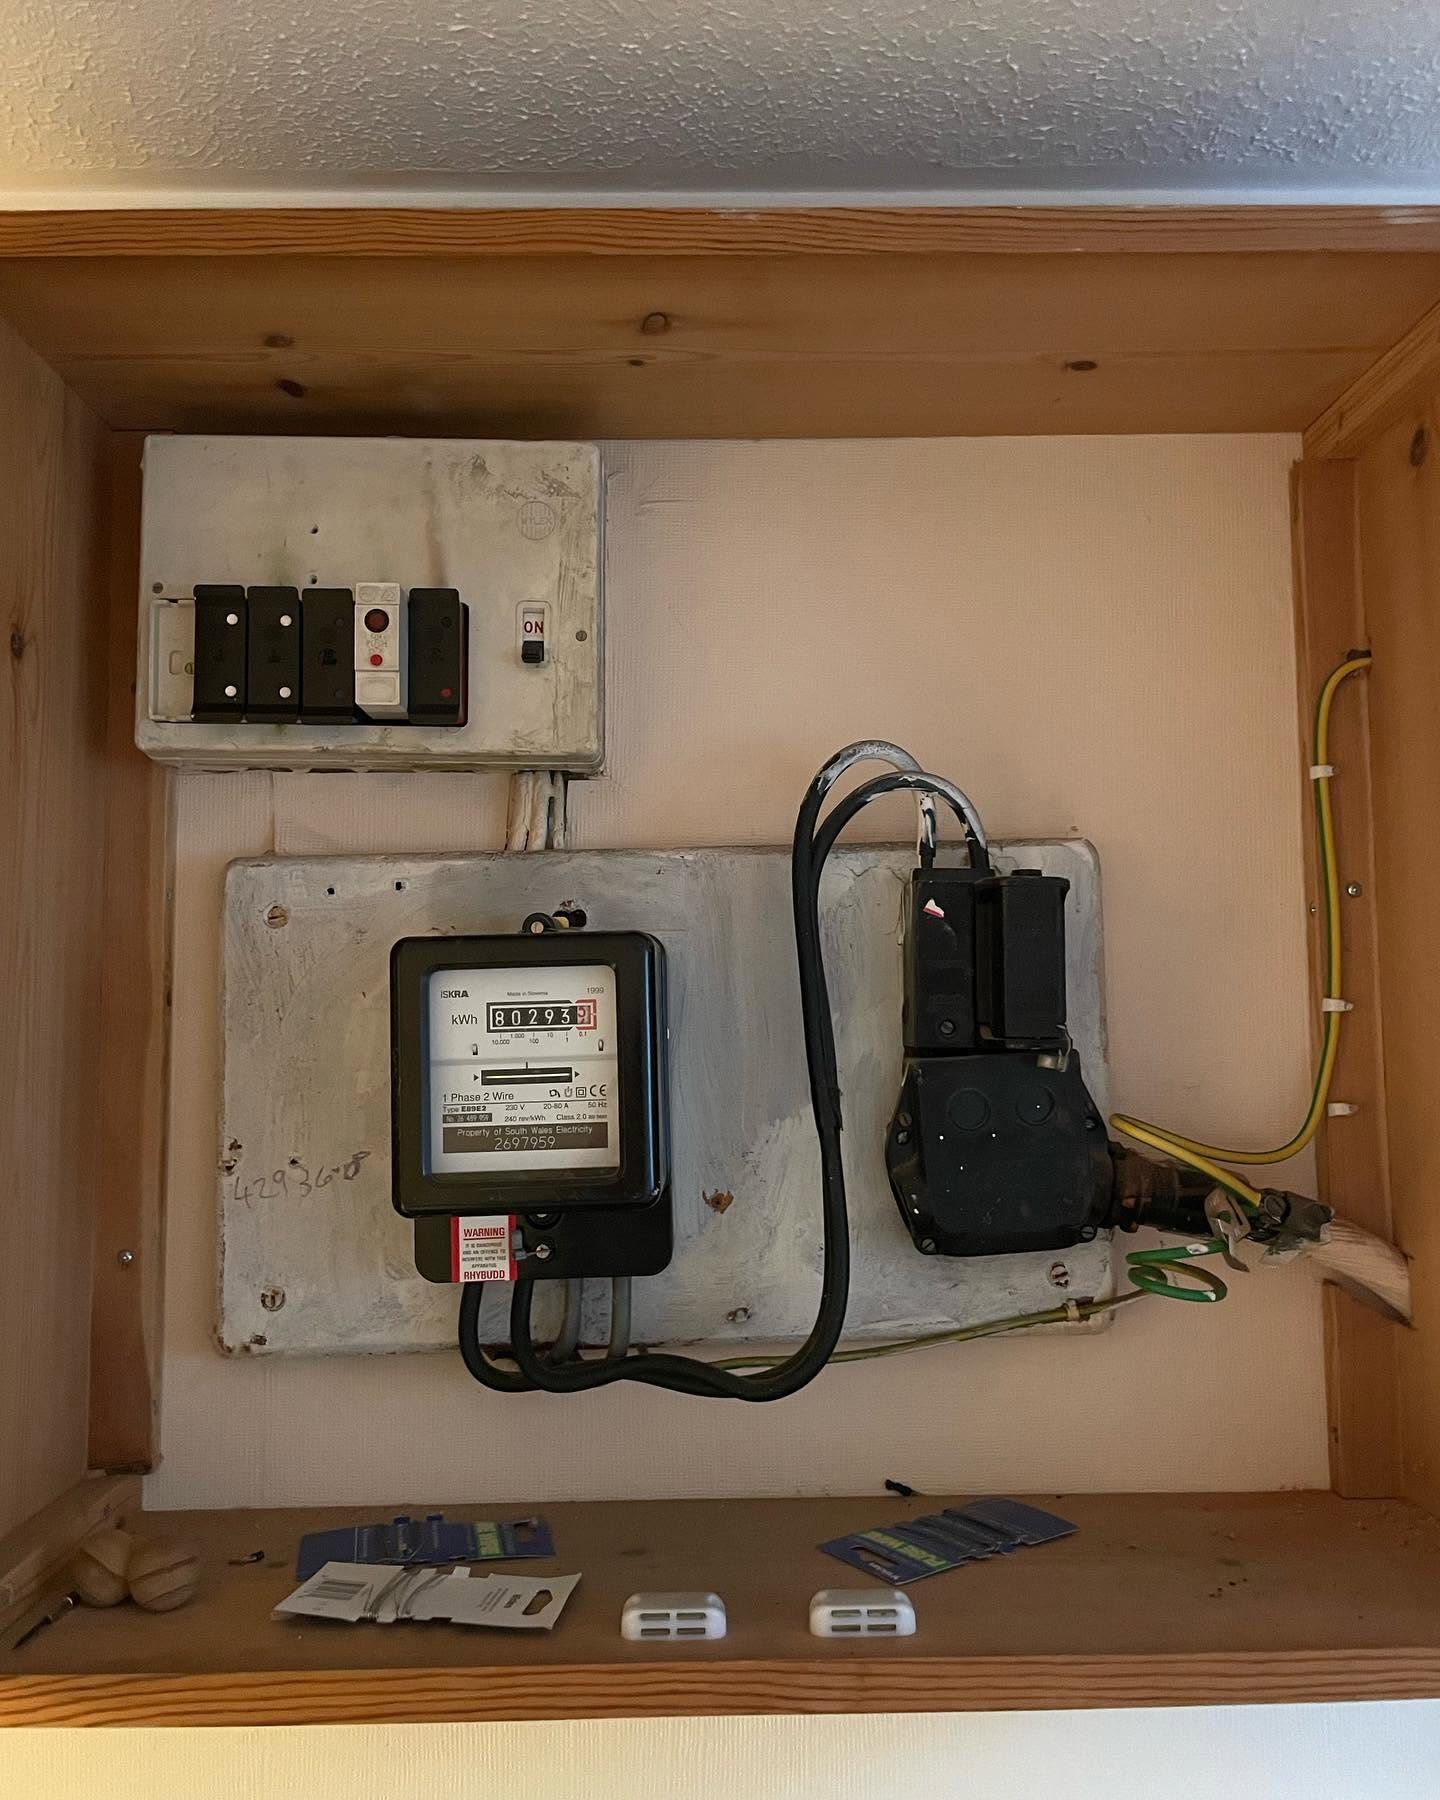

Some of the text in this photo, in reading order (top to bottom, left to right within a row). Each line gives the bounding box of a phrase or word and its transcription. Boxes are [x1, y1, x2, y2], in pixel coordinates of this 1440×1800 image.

[523, 621, 544, 634] ON
[451, 1015, 478, 1025] kWh
[495, 1008, 570, 1026] 80293
[443, 1091, 514, 1102] 1 Phase 2 Wire
[457, 1129, 490, 1137] Property
[505, 1127, 527, 1135] South
[531, 1126, 553, 1134] Wales
[556, 1125, 593, 1134] Electricity
[494, 1136, 556, 1150] 2697959
[463, 1227, 505, 1237] WARNING
[463, 1270, 505, 1280] RHYBUDD
